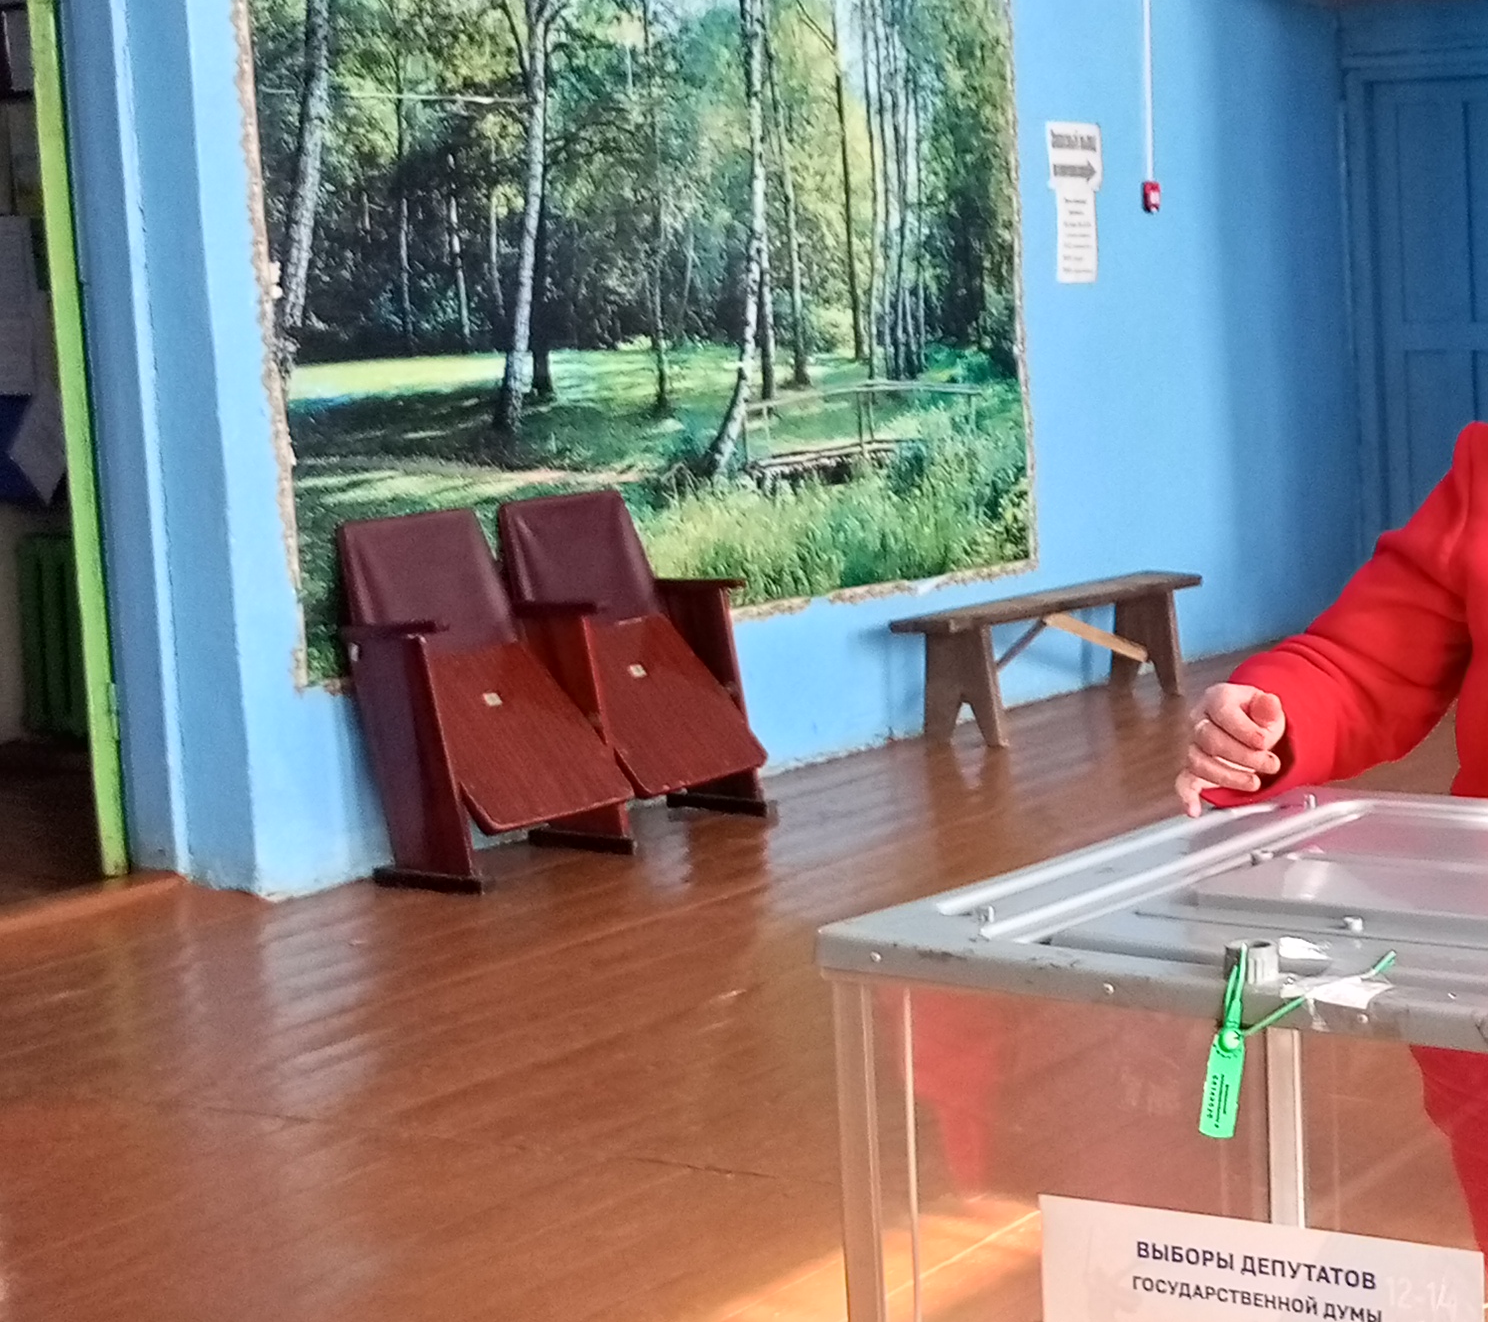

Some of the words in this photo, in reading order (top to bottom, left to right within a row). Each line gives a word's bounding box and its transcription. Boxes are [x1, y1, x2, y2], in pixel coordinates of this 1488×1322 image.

[1136, 1240, 1235, 1272] ВЫБОРЫ
[1240, 1255, 1377, 1291] ДЕПУТАТОВ
[1132, 1275, 1319, 1317] ГОСУДАРСТВЕННОЙ
